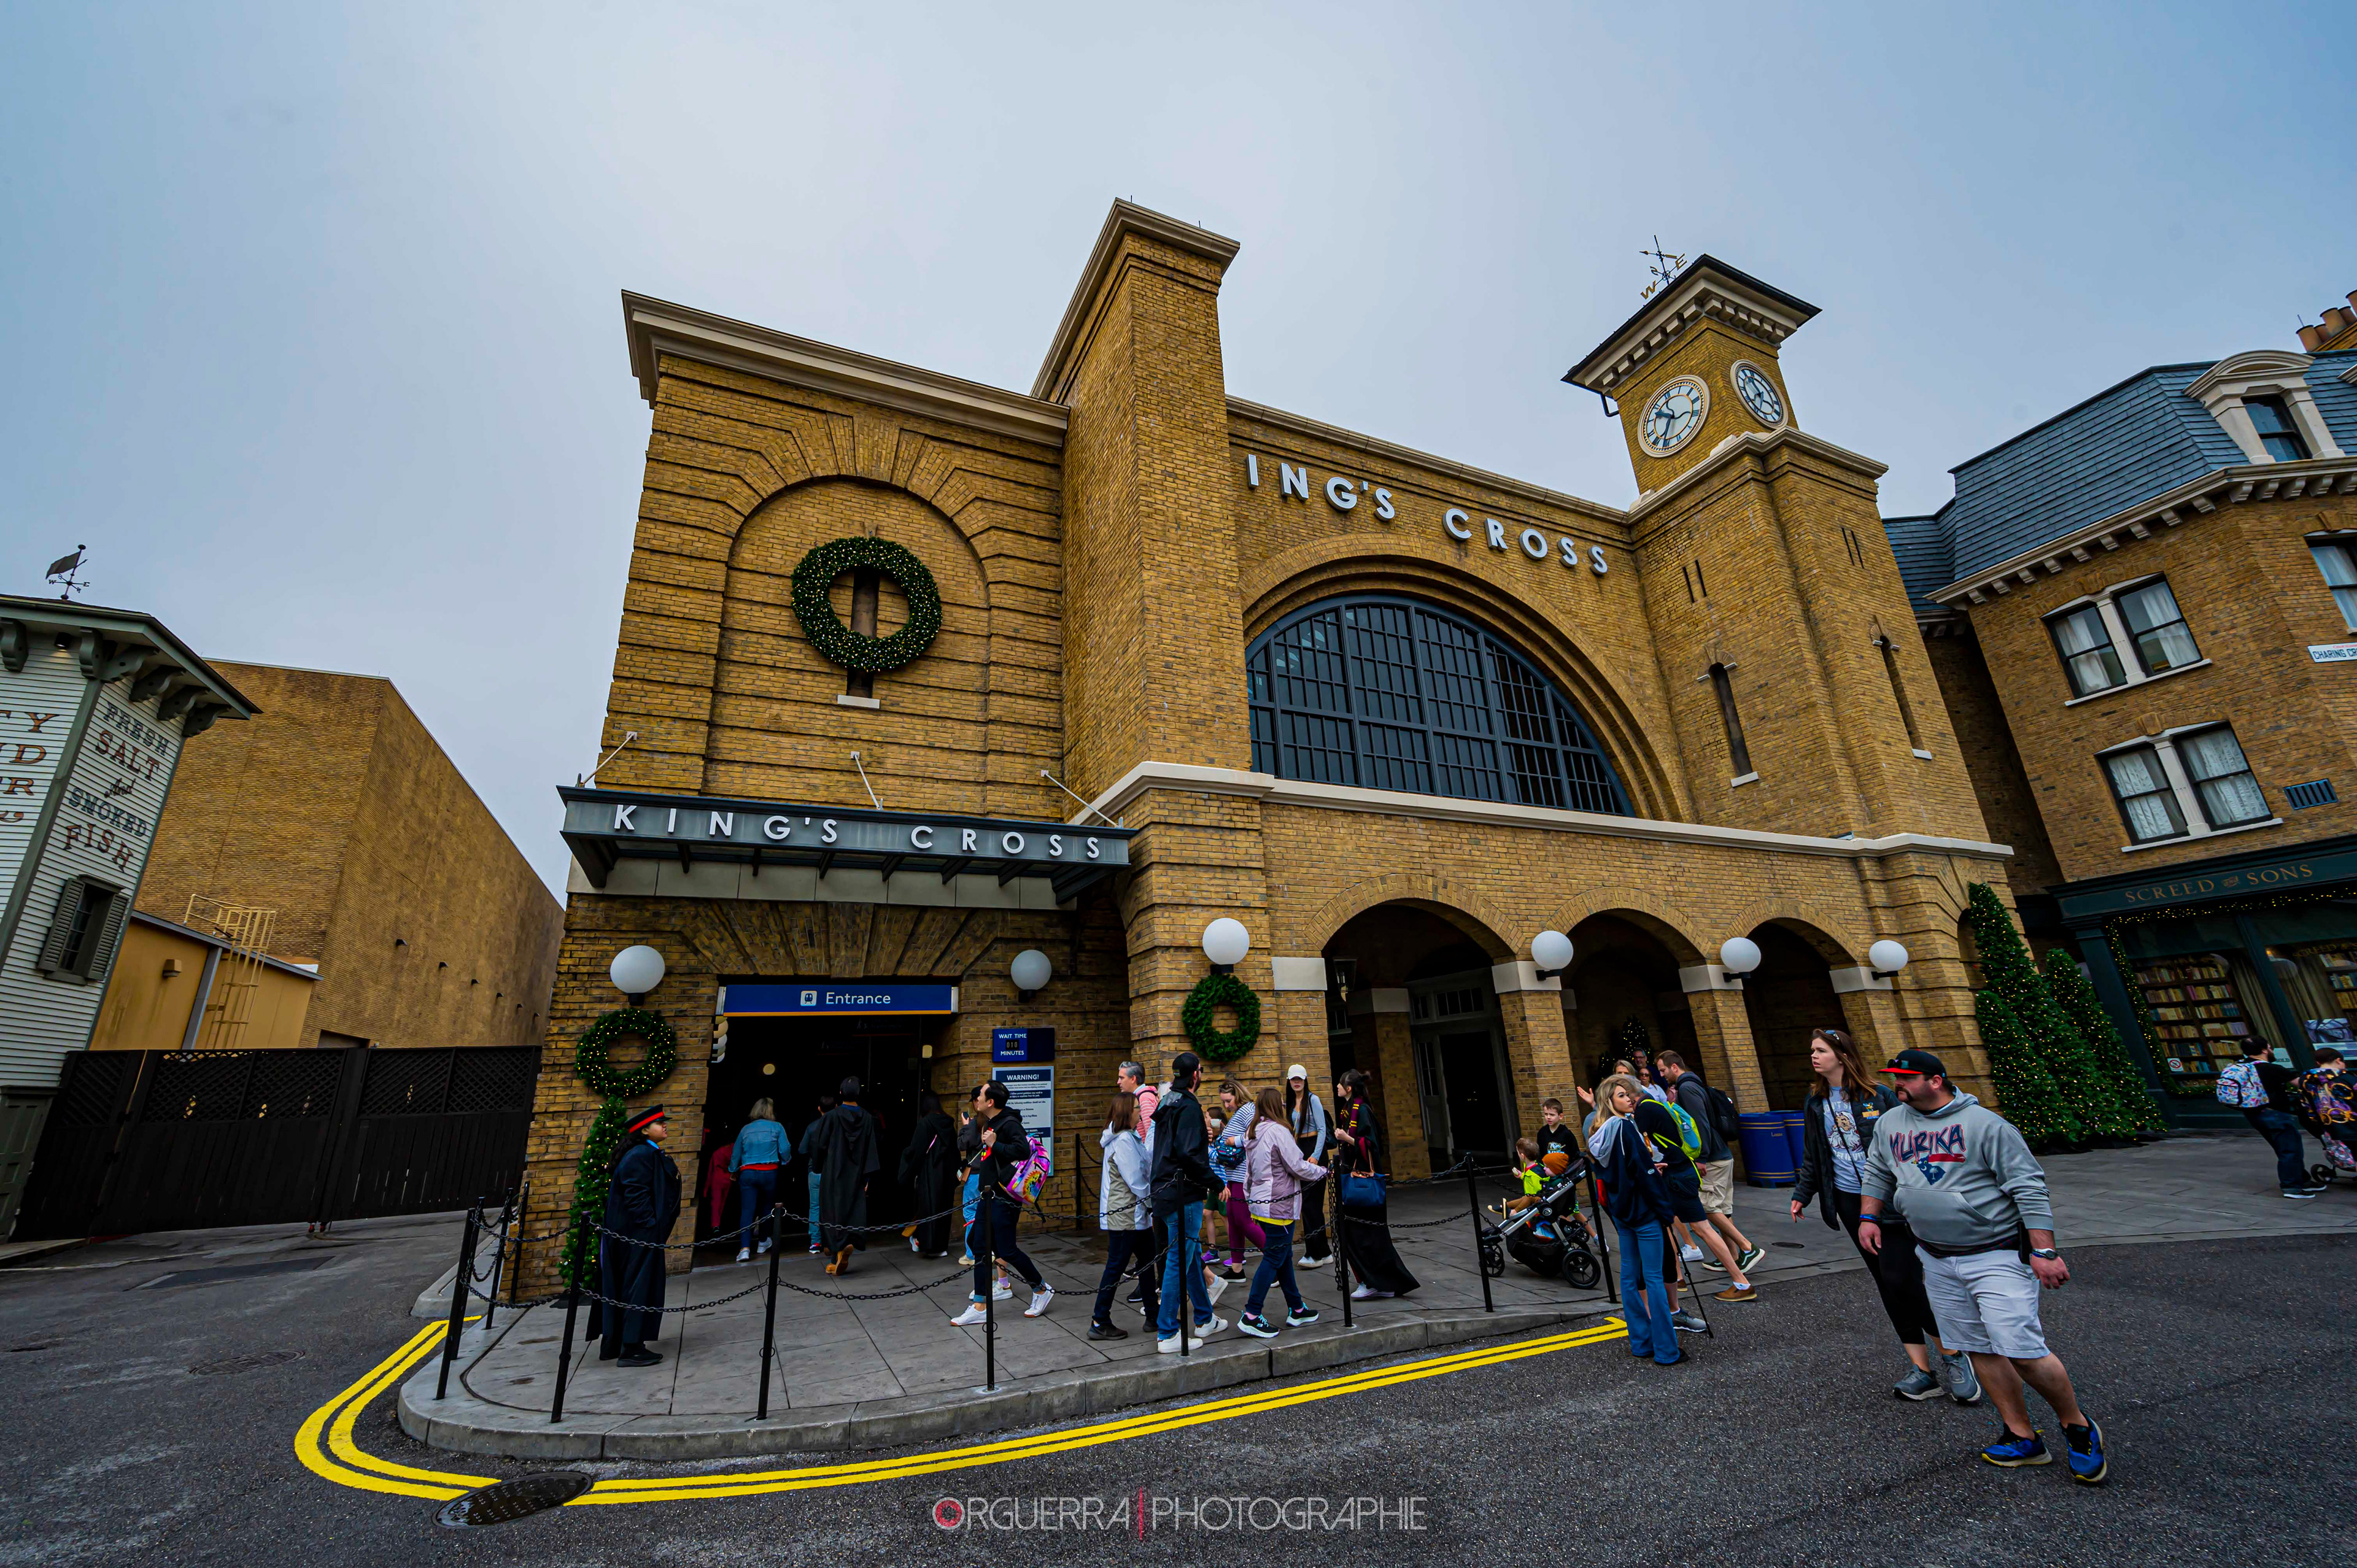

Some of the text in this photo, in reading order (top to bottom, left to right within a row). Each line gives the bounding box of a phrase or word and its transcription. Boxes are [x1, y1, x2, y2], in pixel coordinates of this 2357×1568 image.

[1442, 508, 1608, 575] CROSS
[2312, 648, 2357, 660] CHARING CR
[103, 701, 169, 756] FRESH
[95, 730, 160, 781] SALT
[68, 787, 147, 837] SMOKED
[614, 804, 1100, 859] KING'S CROSS
[63, 824, 134, 873] FISH
[2125, 879, 2214, 903] SCREED
[2247, 864, 2313, 885] SONS
[826, 992, 891, 1005] Entrance
